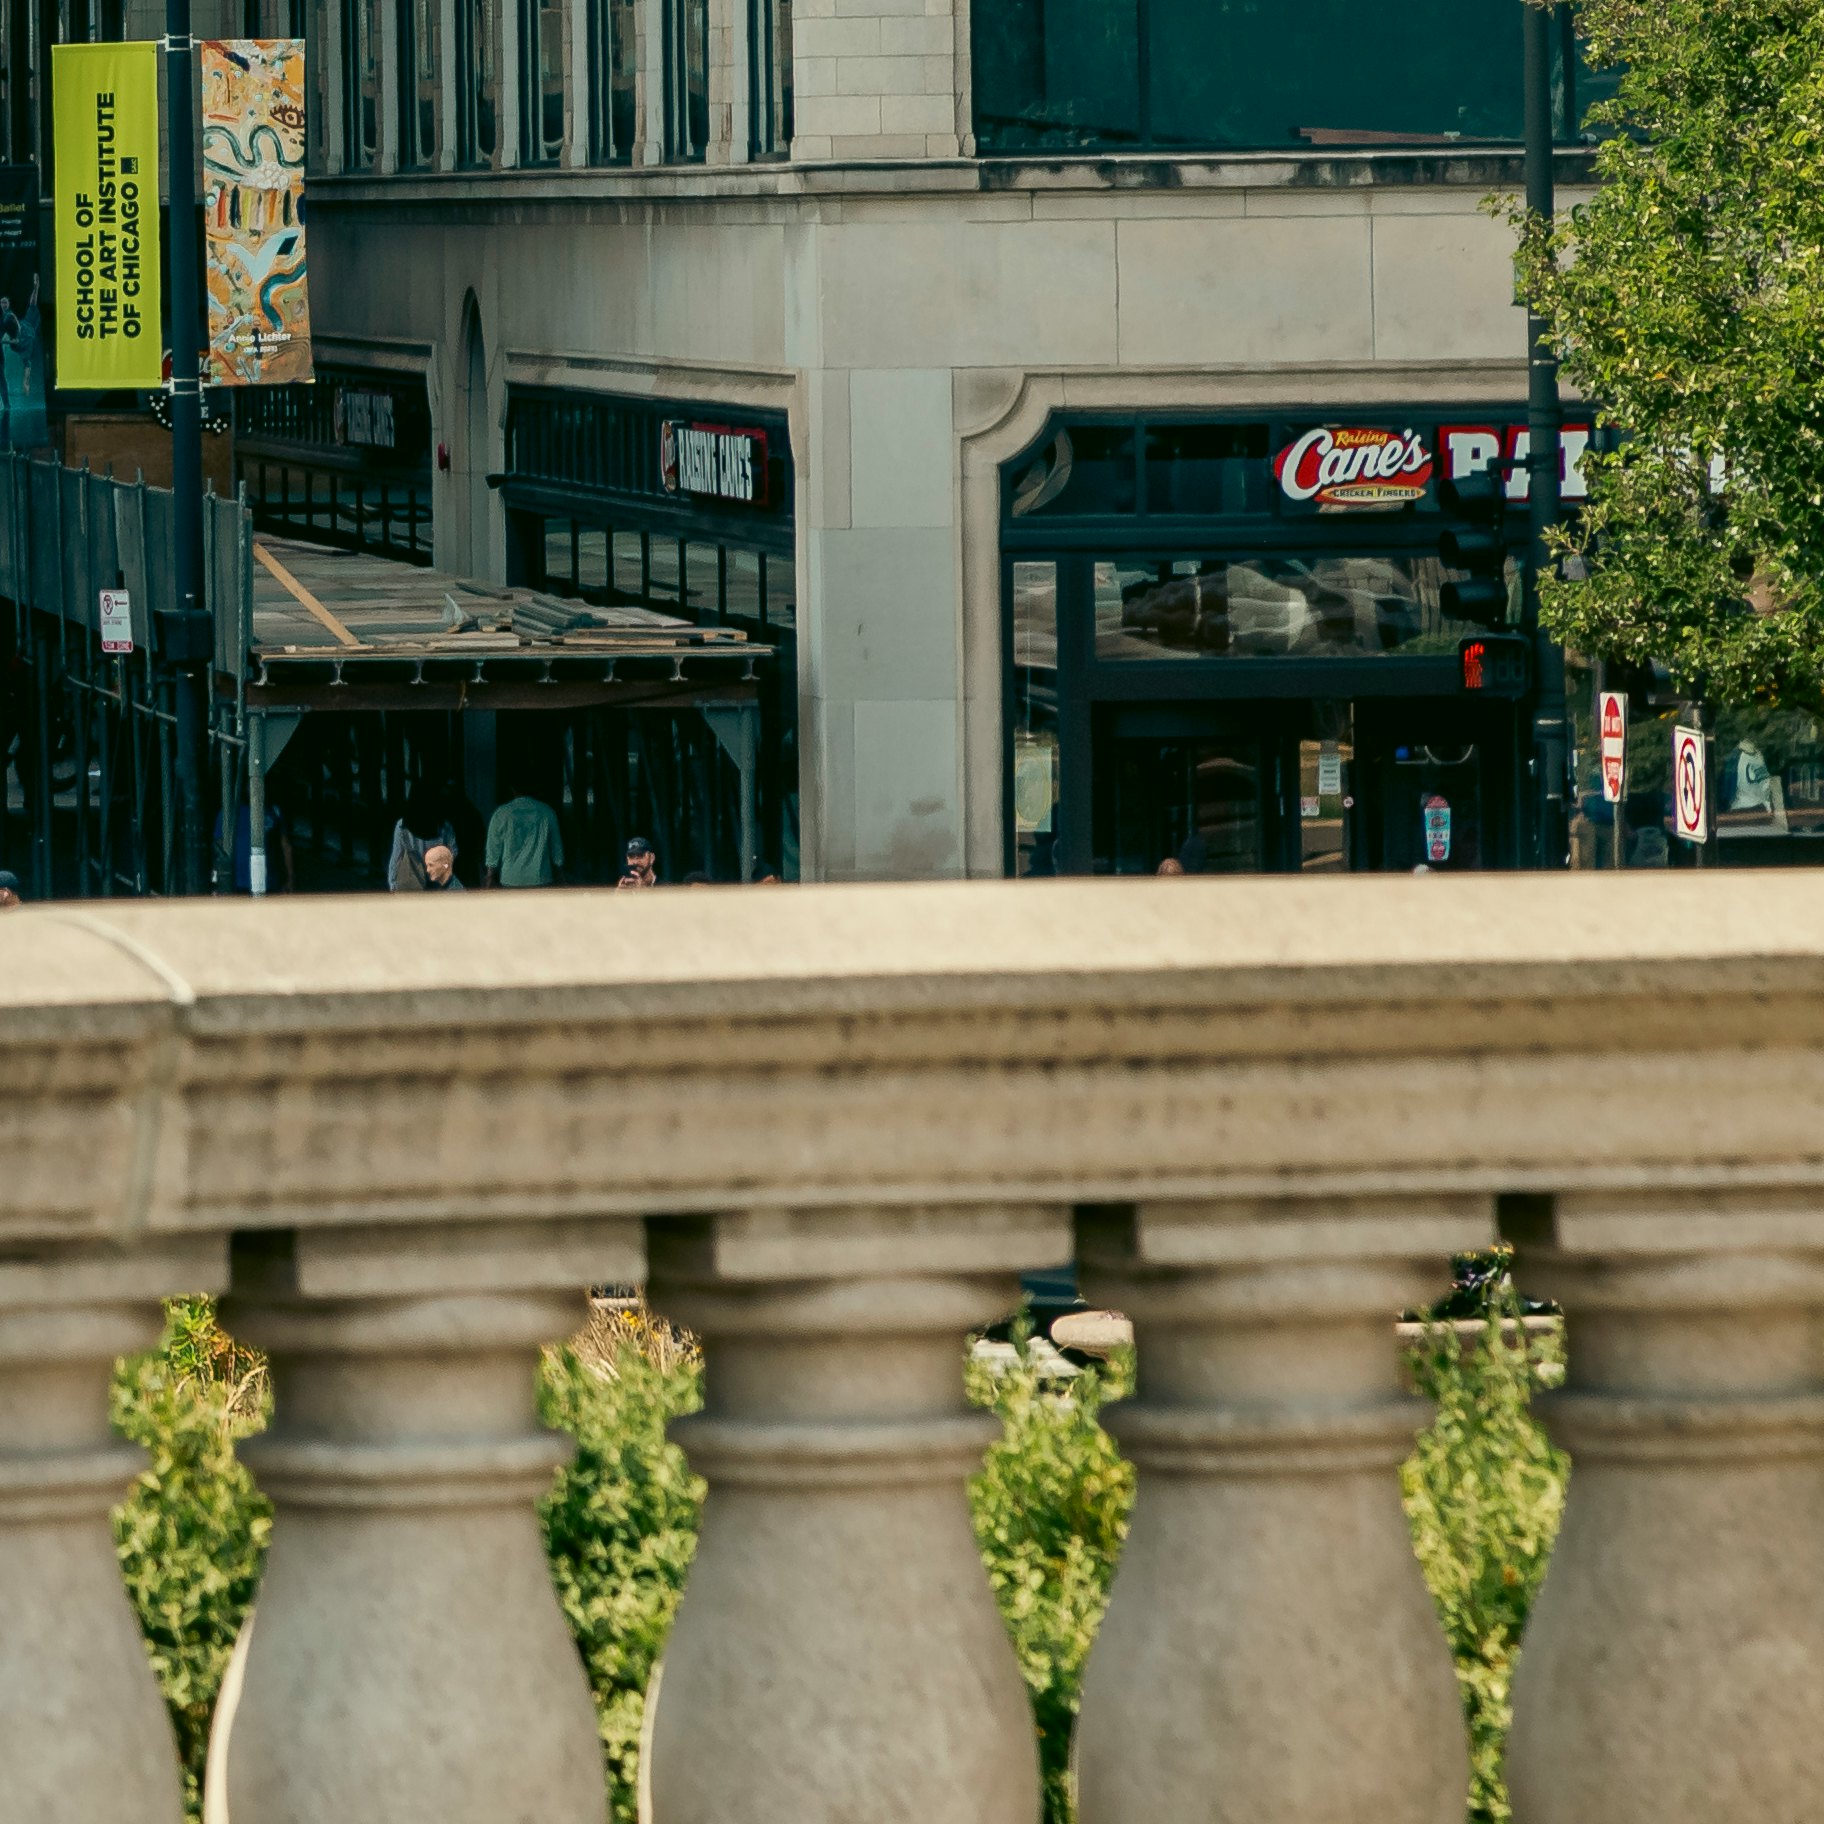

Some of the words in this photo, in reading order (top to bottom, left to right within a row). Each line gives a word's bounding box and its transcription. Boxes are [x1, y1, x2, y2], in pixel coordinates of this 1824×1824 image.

[97, 93, 117, 225] INSTITUTE
[76, 193, 94, 228] OF
[99, 231, 118, 283] ART
[121, 182, 141, 298] CHICAGO
[76, 234, 95, 339] SCHOOL
[99, 290, 118, 339] THE
[122, 304, 142, 339] OF
[259, 332, 292, 342] Lichter
[1335, 429, 1388, 447] Raising
[1281, 427, 1432, 501] Cane's
[1333, 488, 1374, 499] CHICKEN
[1376, 488, 1417, 499] FINGERS
